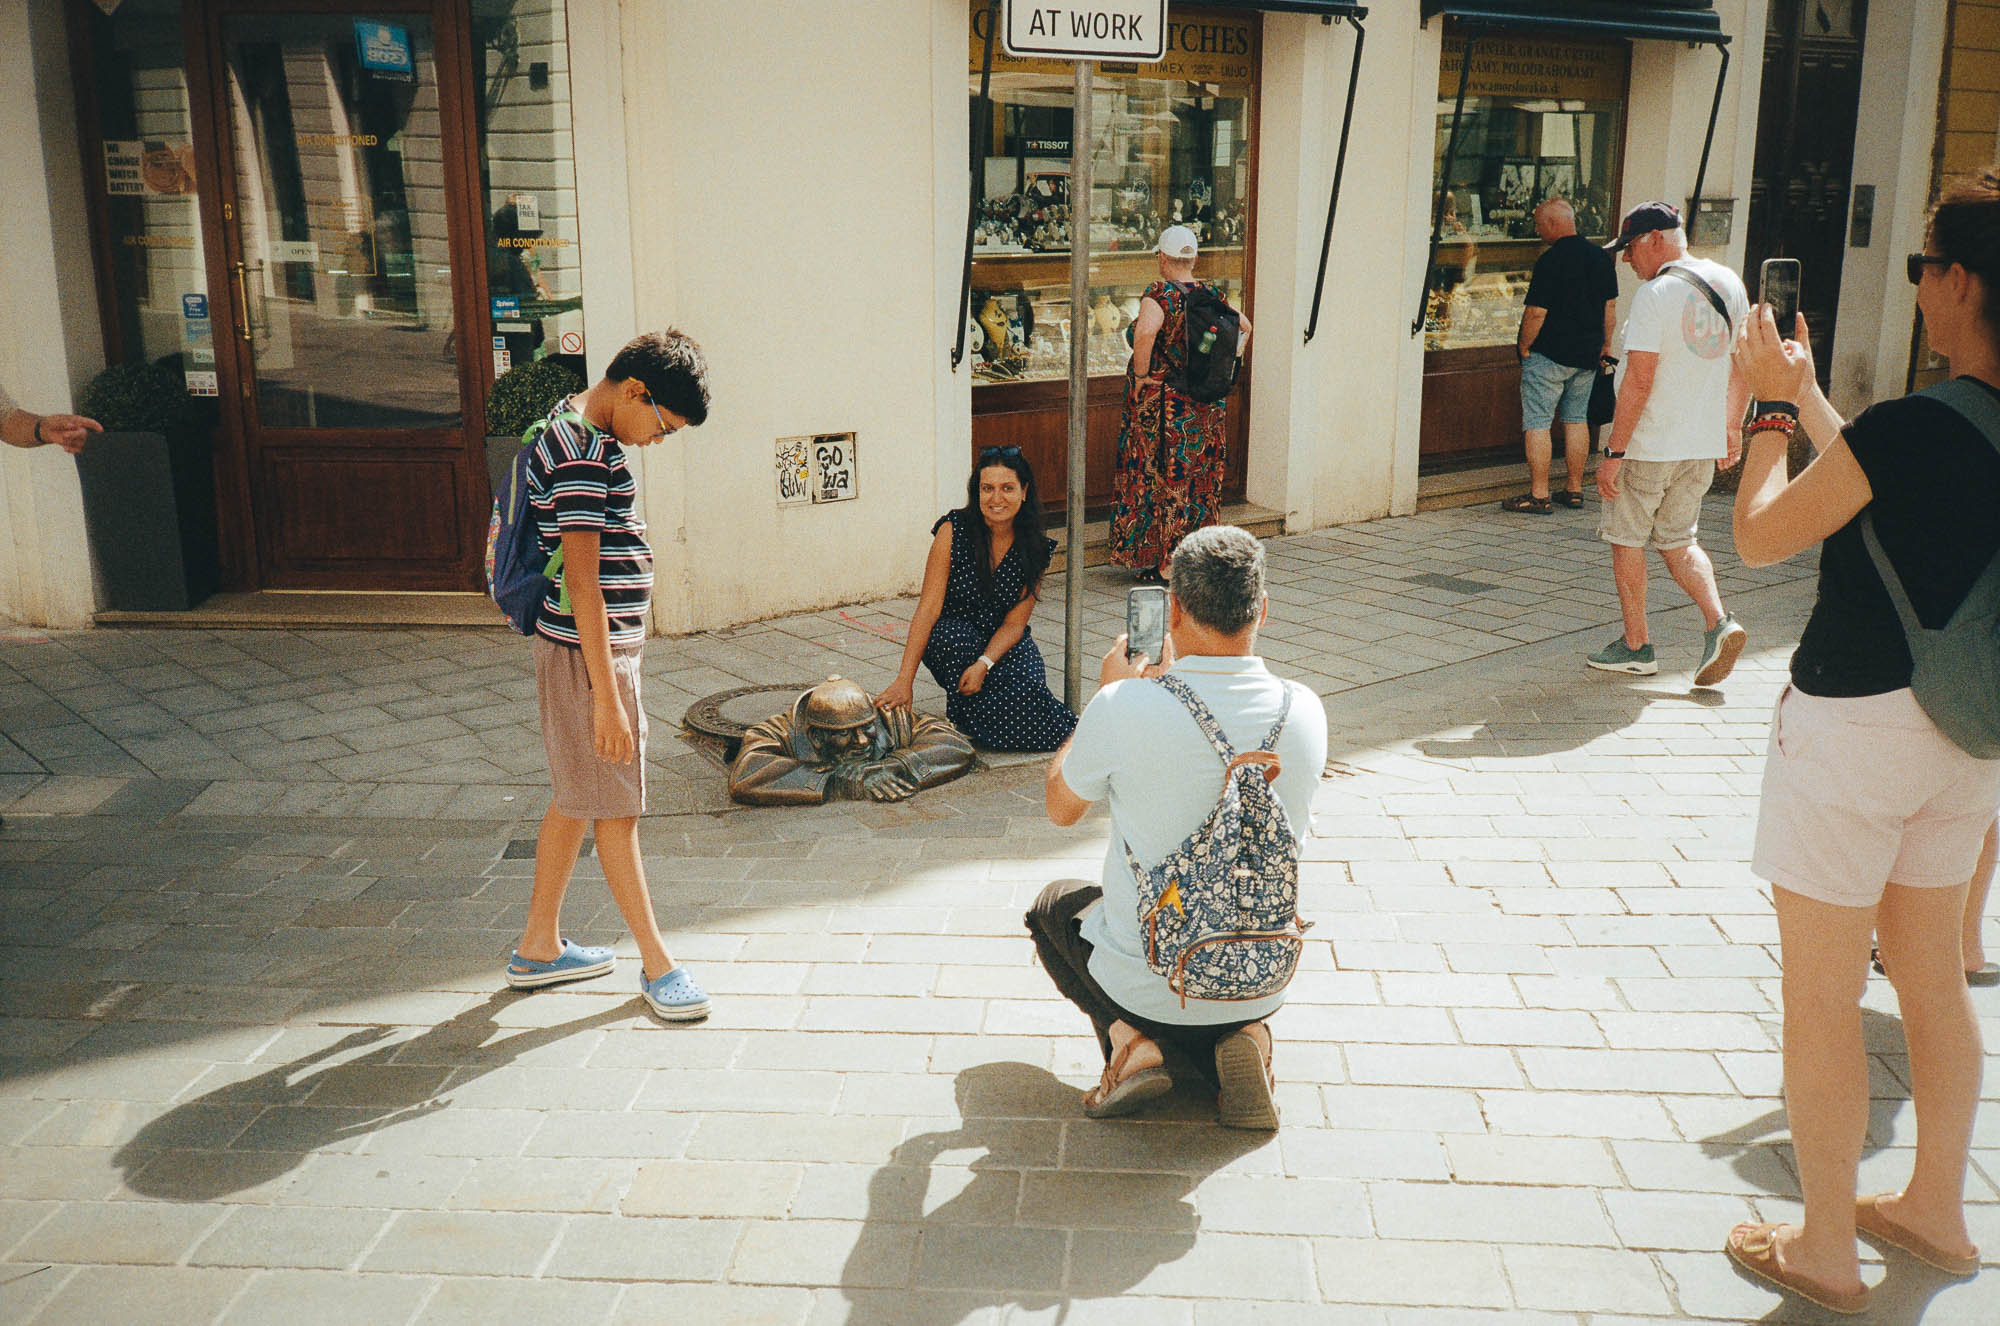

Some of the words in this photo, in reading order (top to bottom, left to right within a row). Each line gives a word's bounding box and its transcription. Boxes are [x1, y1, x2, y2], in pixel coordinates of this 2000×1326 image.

[1029, 8, 1062, 37] AT
[1070, 10, 1143, 41] WORK
[1167, 22, 1249, 55] TCHES
[1148, 63, 1185, 74] TIMEX
[314, 135, 378, 147] CONDITIONED
[110, 182, 145, 193] BATTERY
[519, 210, 536, 218] FREE
[497, 237, 511, 248] AIR
[512, 237, 569, 248] CONDITIONED
[291, 247, 311, 255] OPEN
